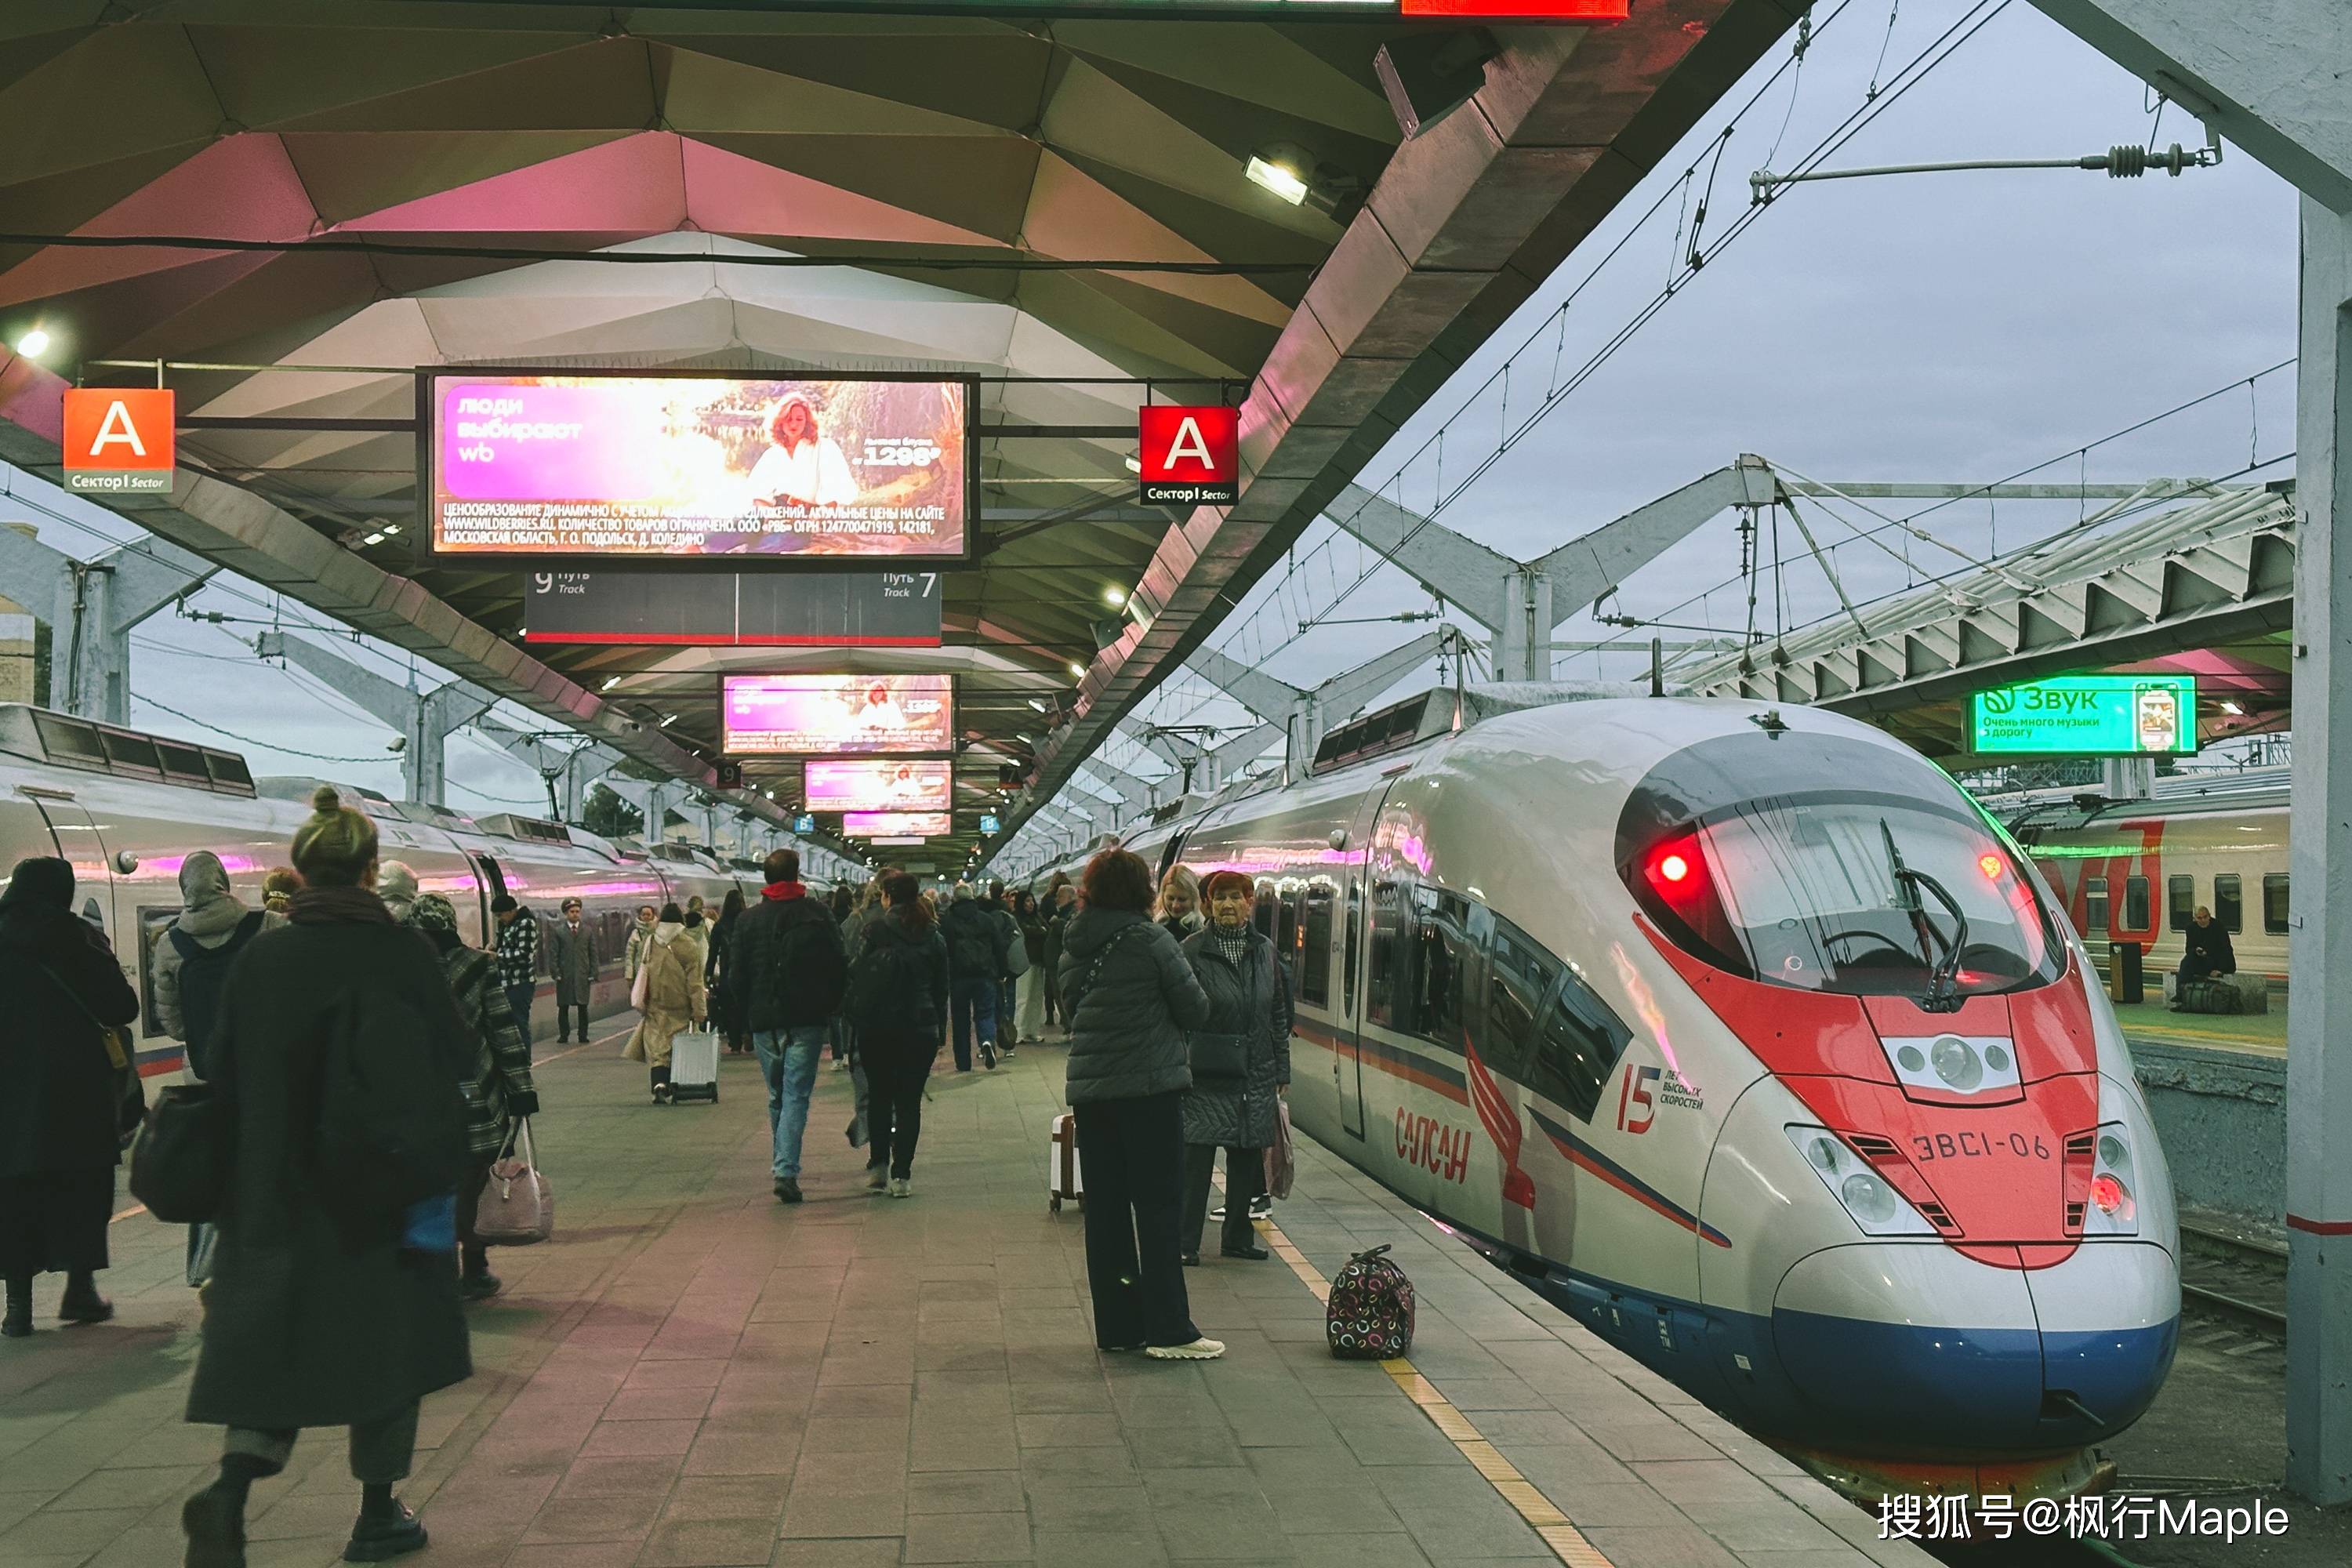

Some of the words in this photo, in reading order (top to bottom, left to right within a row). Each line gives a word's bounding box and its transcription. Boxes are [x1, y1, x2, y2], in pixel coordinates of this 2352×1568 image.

[457, 397, 524, 417] люди
[89, 401, 147, 456] А
[457, 417, 583, 444] выбирают
[458, 441, 495, 463] wb
[1163, 416, 1215, 470] А
[71, 474, 122, 491] Сектор
[131, 477, 164, 488] Sector
[1147, 488, 1193, 503] Сектор
[1201, 490, 1231, 500] Sector
[444, 503, 542, 517] ЦЕНООБРАЗОВАНИЕ
[543, 504, 609, 518] ДИНАМИЧНО
[872, 506, 898, 522] ЦЕНЫ
[902, 507, 913, 520] НА
[915, 504, 945, 521] САЙТЕ
[557, 517, 622, 532] КОЛИЧЕСТВО
[623, 518, 667, 532] ТОВАРОВ
[670, 519, 737, 532] ОГРАНИЧЕНО.
[737, 519, 761, 533] ООО
[793, 521, 819, 533] ОГРН
[444, 531, 511, 545] МОСКОВСКАЯ
[512, 532, 559, 546] ОБЛАСТЬ,
[582, 532, 637, 547] ПОДОЛЬСК,
[651, 532, 705, 546] КОЛЕДИНО
[535, 572, 553, 594] 9
[558, 584, 586, 594] Track
[884, 587, 910, 597] Track
[919, 572, 937, 598] 7
[2024, 686, 2099, 715] Звук
[1984, 717, 2019, 727] Очень
[2020, 718, 2055, 727] много
[2056, 718, 2100, 728] музыки
[1992, 729, 2033, 739] дорогу
[724, 766, 735, 782] 9
[1617, 1063, 1661, 1134] 15
[1660, 1093, 1704, 1111] СКОРОСТЕЙ
[1396, 1105, 1472, 1185] САПСАН
